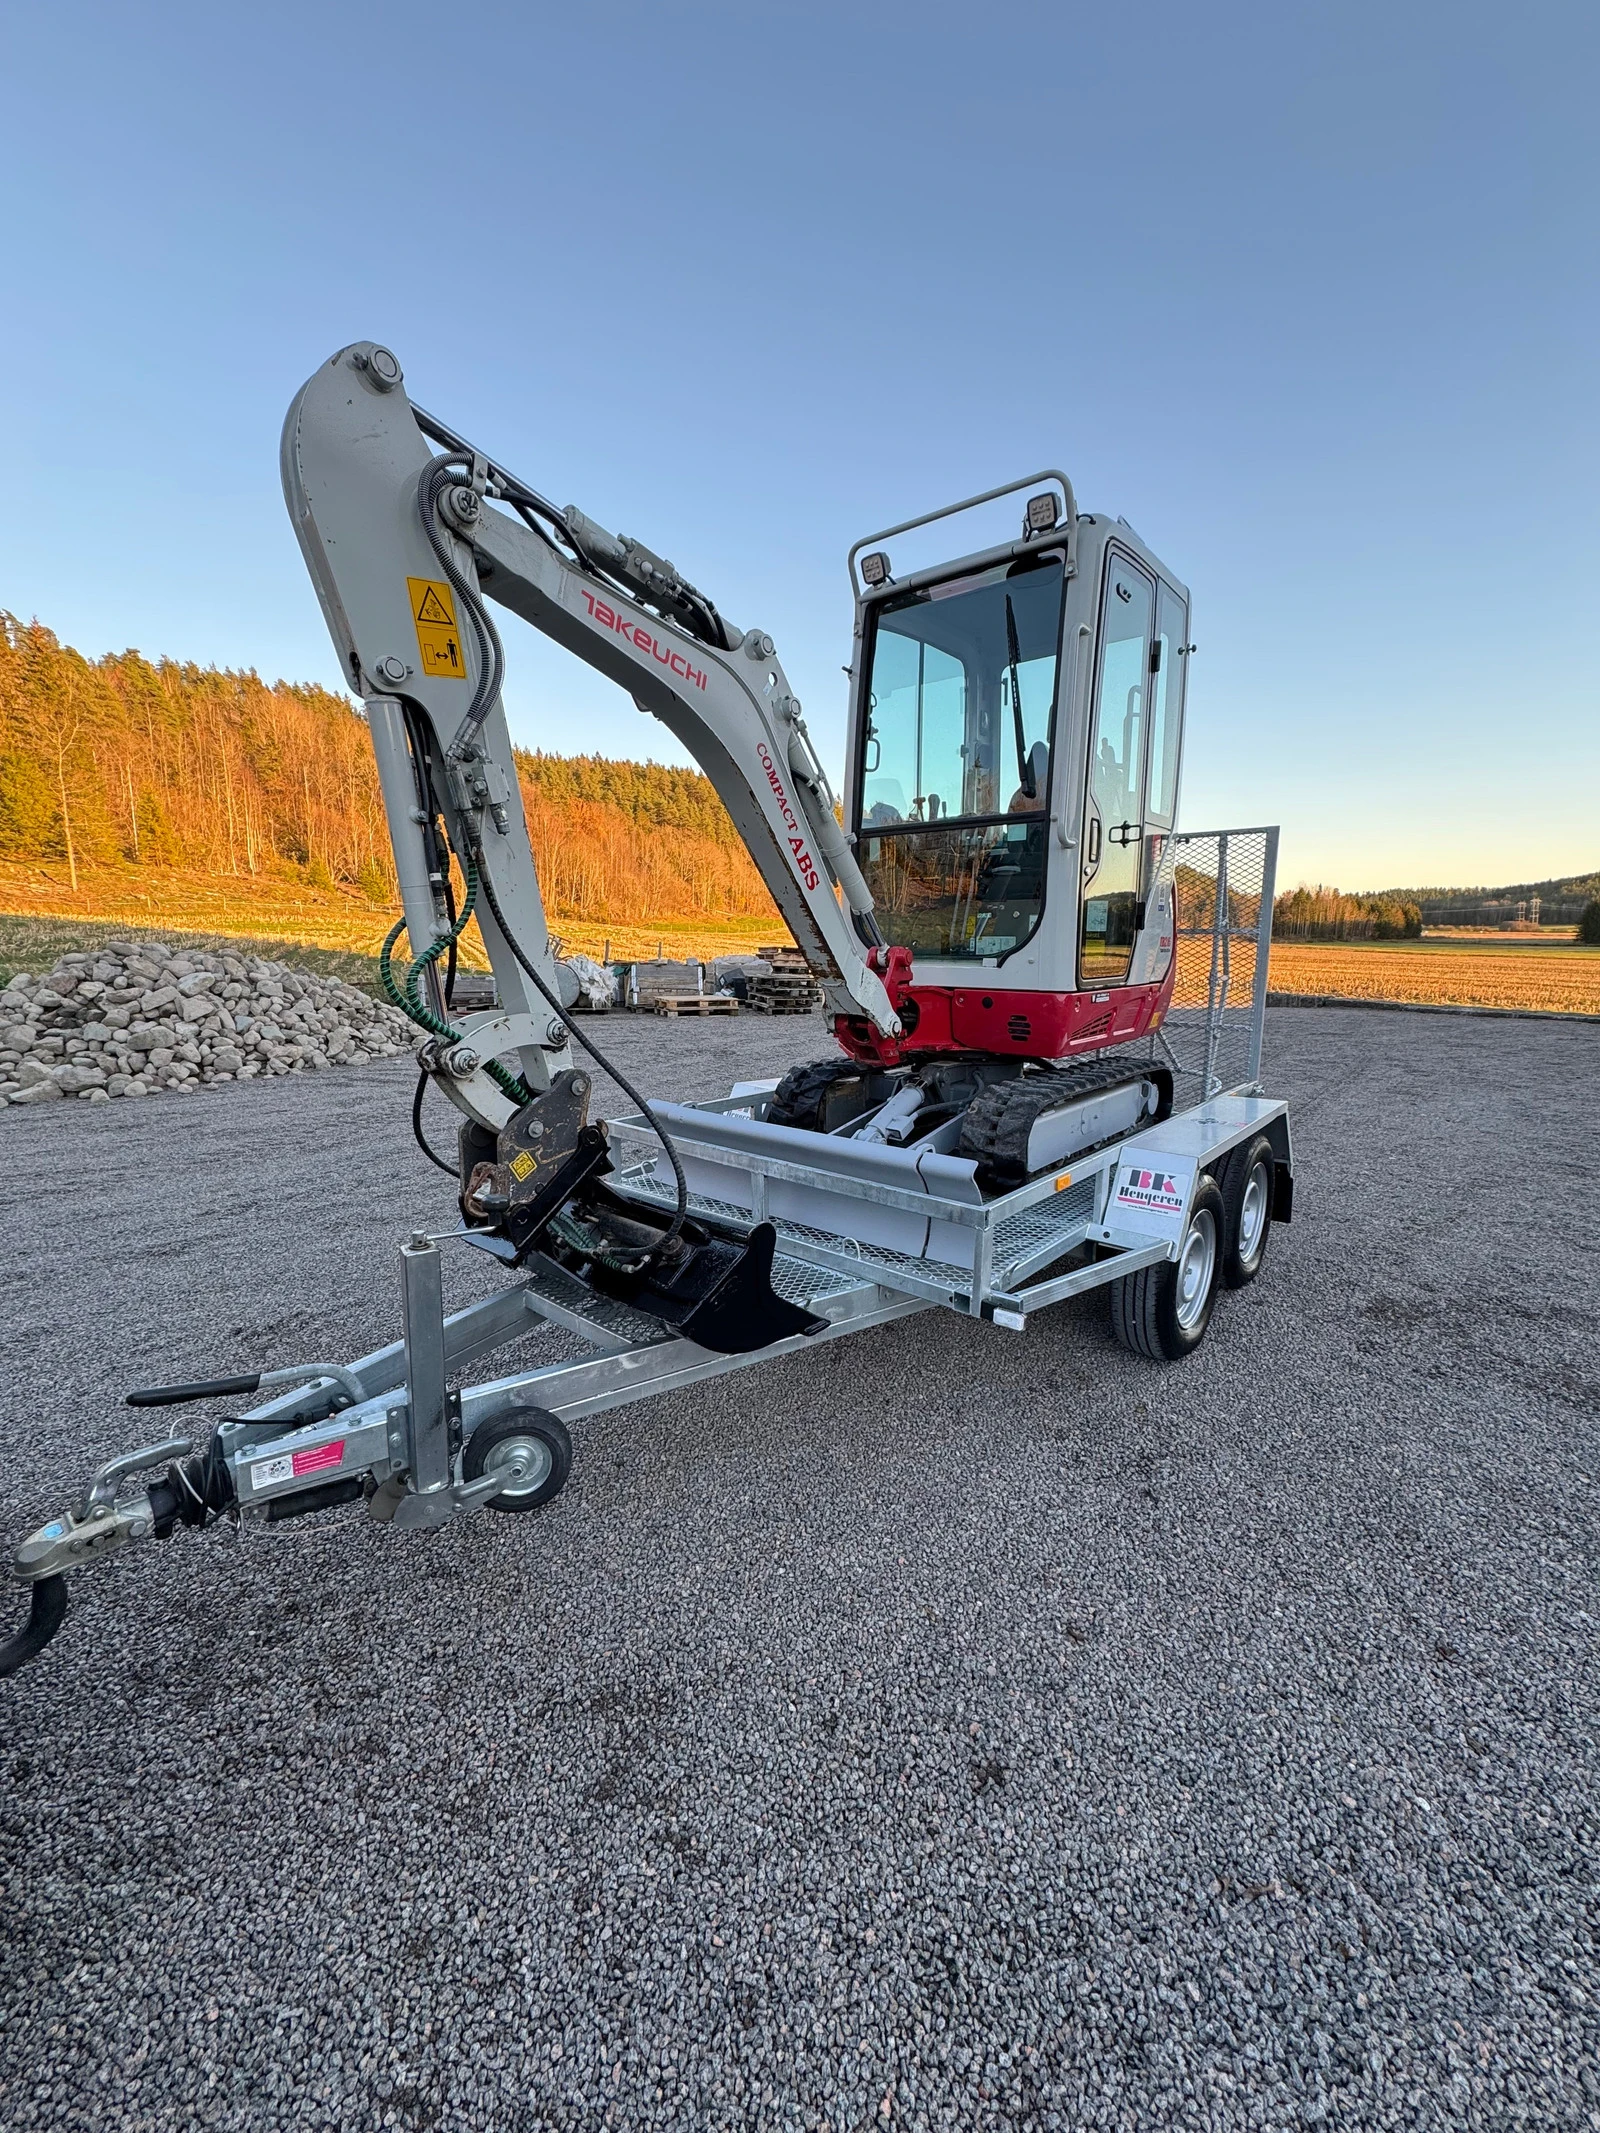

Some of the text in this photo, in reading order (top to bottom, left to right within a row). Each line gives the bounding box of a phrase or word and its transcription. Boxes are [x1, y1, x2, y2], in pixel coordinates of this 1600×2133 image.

[756, 742, 821, 892] COMPACT ABS
[1128, 1169, 1177, 1194] BK
